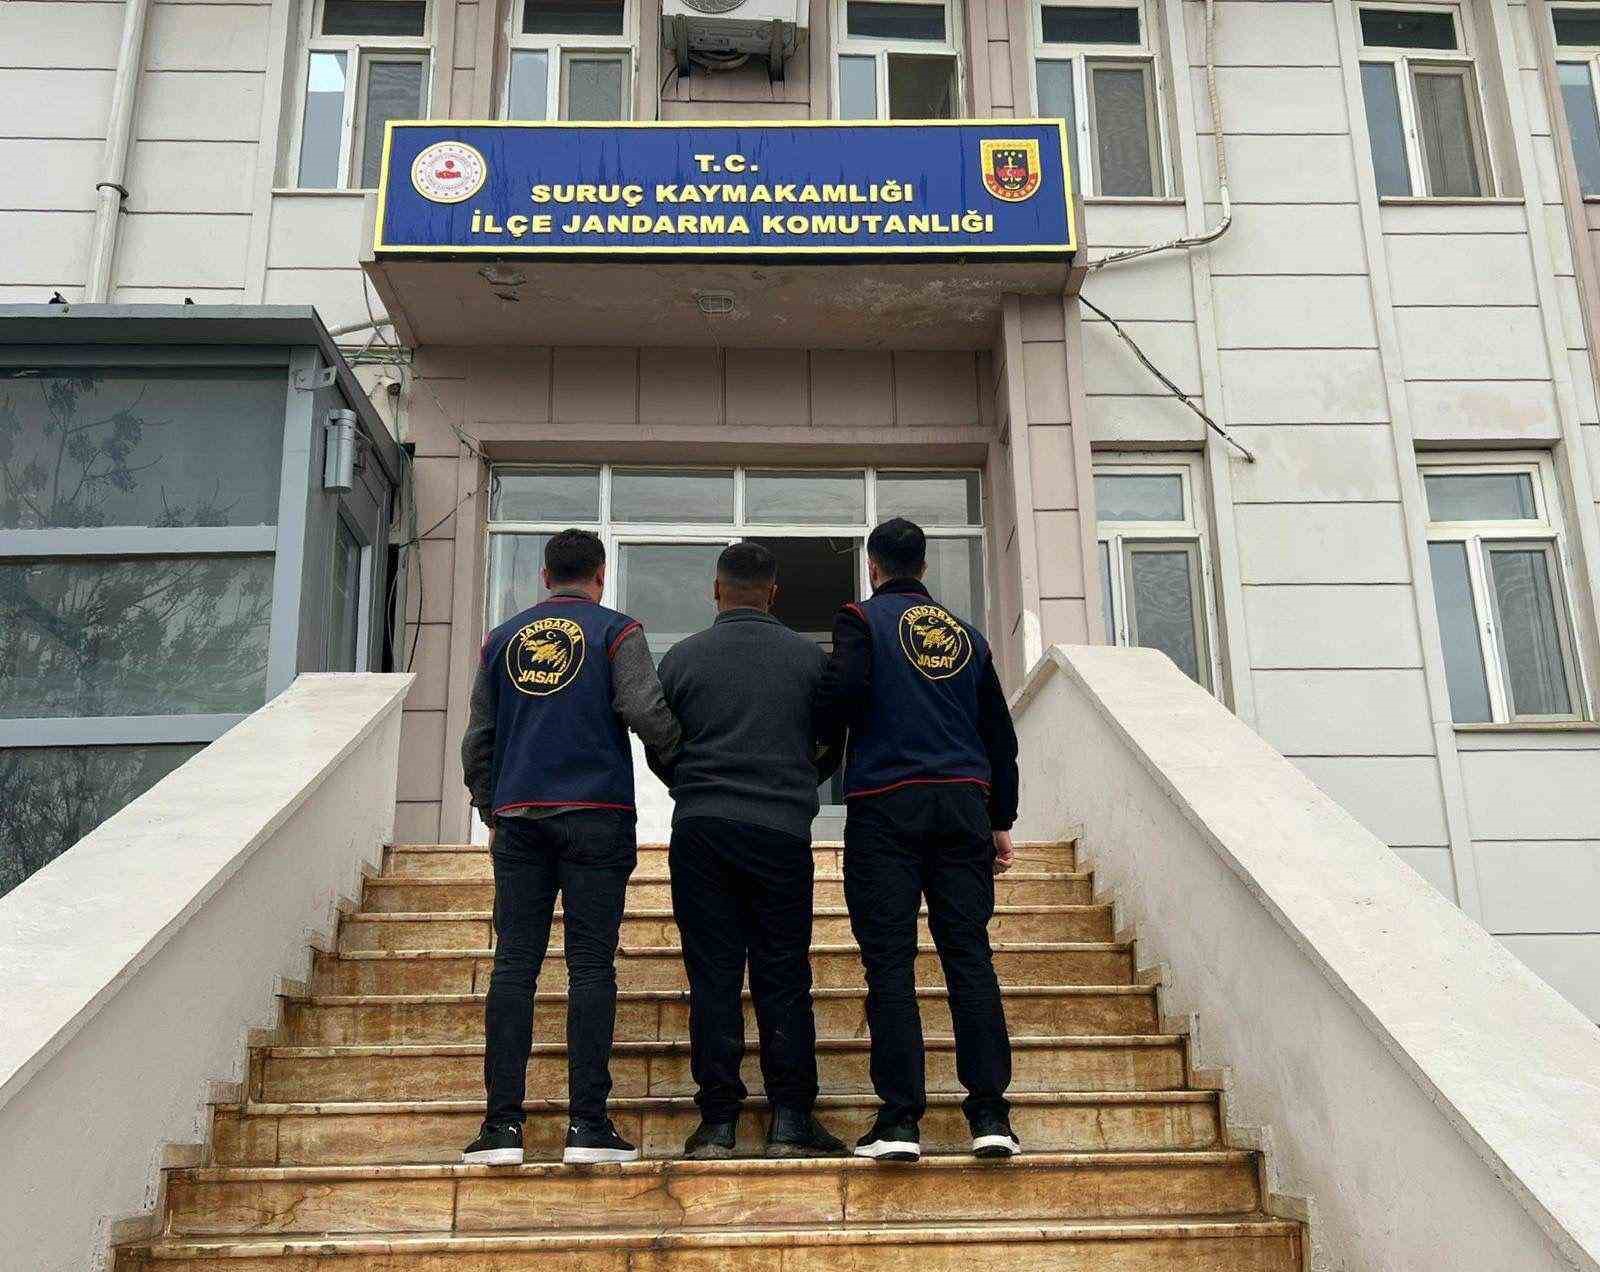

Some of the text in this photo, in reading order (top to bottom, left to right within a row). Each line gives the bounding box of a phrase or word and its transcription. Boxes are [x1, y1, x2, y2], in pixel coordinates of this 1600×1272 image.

[694, 154, 760, 173] T.C.
[530, 180, 913, 208] SURUÇ KAYMAKAMLIĞI
[471, 209, 994, 238] İLÇE JANDARMA KOMUTANLIĞI
[519, 620, 582, 644] JANDARMA
[918, 654, 956, 669] JASAT
[518, 669, 563, 685] JASAT
